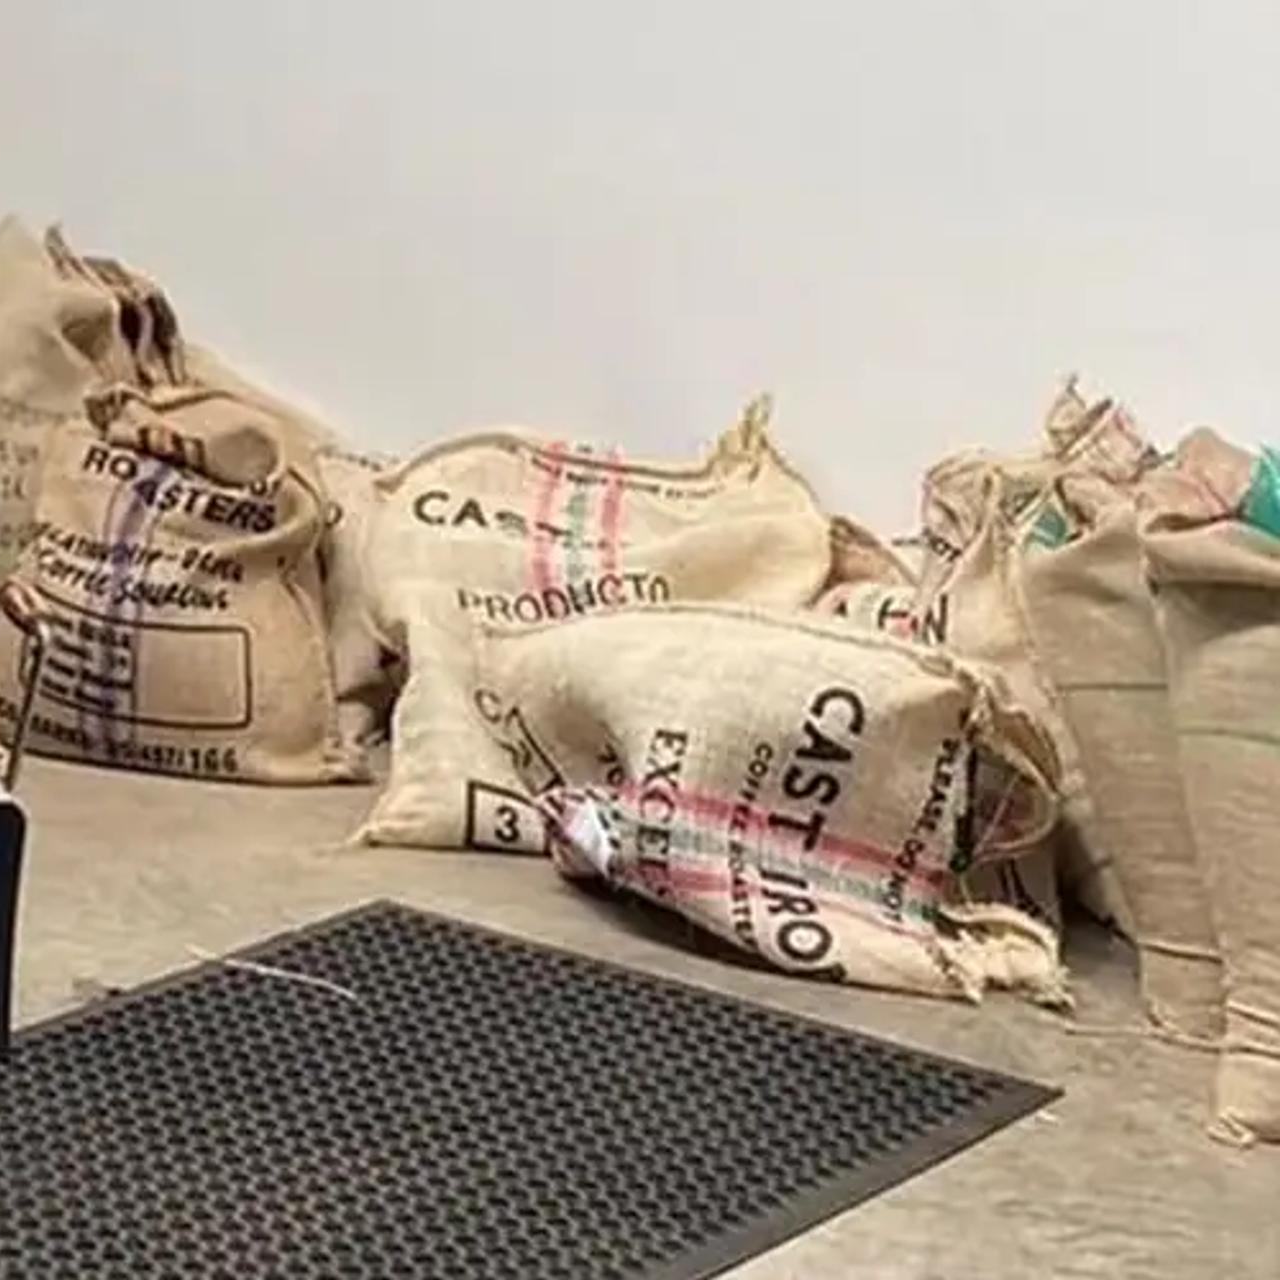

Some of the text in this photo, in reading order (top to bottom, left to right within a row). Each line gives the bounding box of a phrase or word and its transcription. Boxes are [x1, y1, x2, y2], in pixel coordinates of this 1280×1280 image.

[83, 444, 277, 533] ROASTERS
[768, 687, 866, 852] CAST
[494, 805, 520, 843] 3
